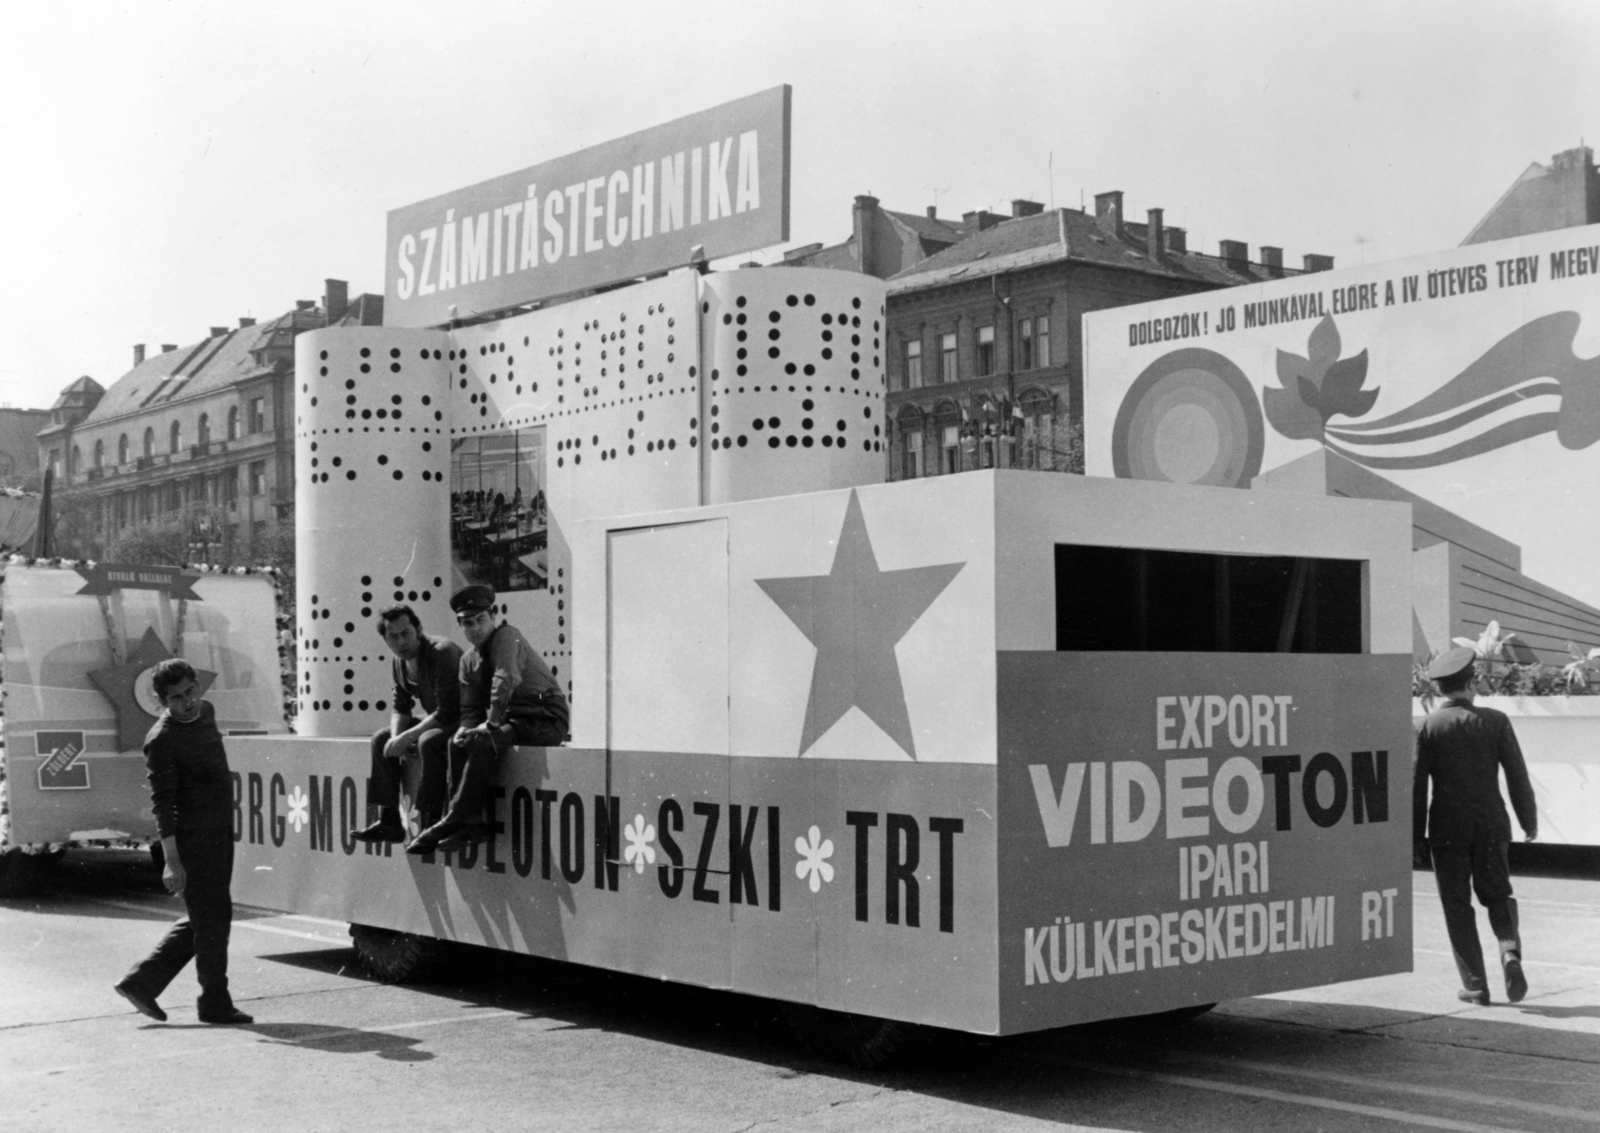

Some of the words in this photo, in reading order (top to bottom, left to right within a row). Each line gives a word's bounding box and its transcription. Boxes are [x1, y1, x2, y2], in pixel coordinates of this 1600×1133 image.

[397, 129, 760, 300] SZÁMITÁSTECHNIKA
[1216, 303, 1236, 333] JÓ
[1244, 291, 1326, 329] MUNKÁVAL
[1332, 283, 1379, 315] ELŐRE
[1384, 279, 1396, 307] A
[1402, 274, 1422, 304] IV.
[1427, 263, 1488, 299] ÖTÉVES
[1495, 255, 1540, 288] TERV
[1550, 245, 1600, 280] MEGV
[1156, 694, 1293, 750] EXPORT
[1028, 750, 1389, 848] VIDEOTON
[231, 771, 286, 848] BRG
[421, 785, 620, 893] EOTON
[657, 797, 781, 912] SZKI
[846, 810, 964, 934] TRT
[1179, 840, 1269, 901] IPARI
[1024, 895, 1335, 986] KÜLKERESKEDELMI
[1361, 887, 1398, 942] RT
